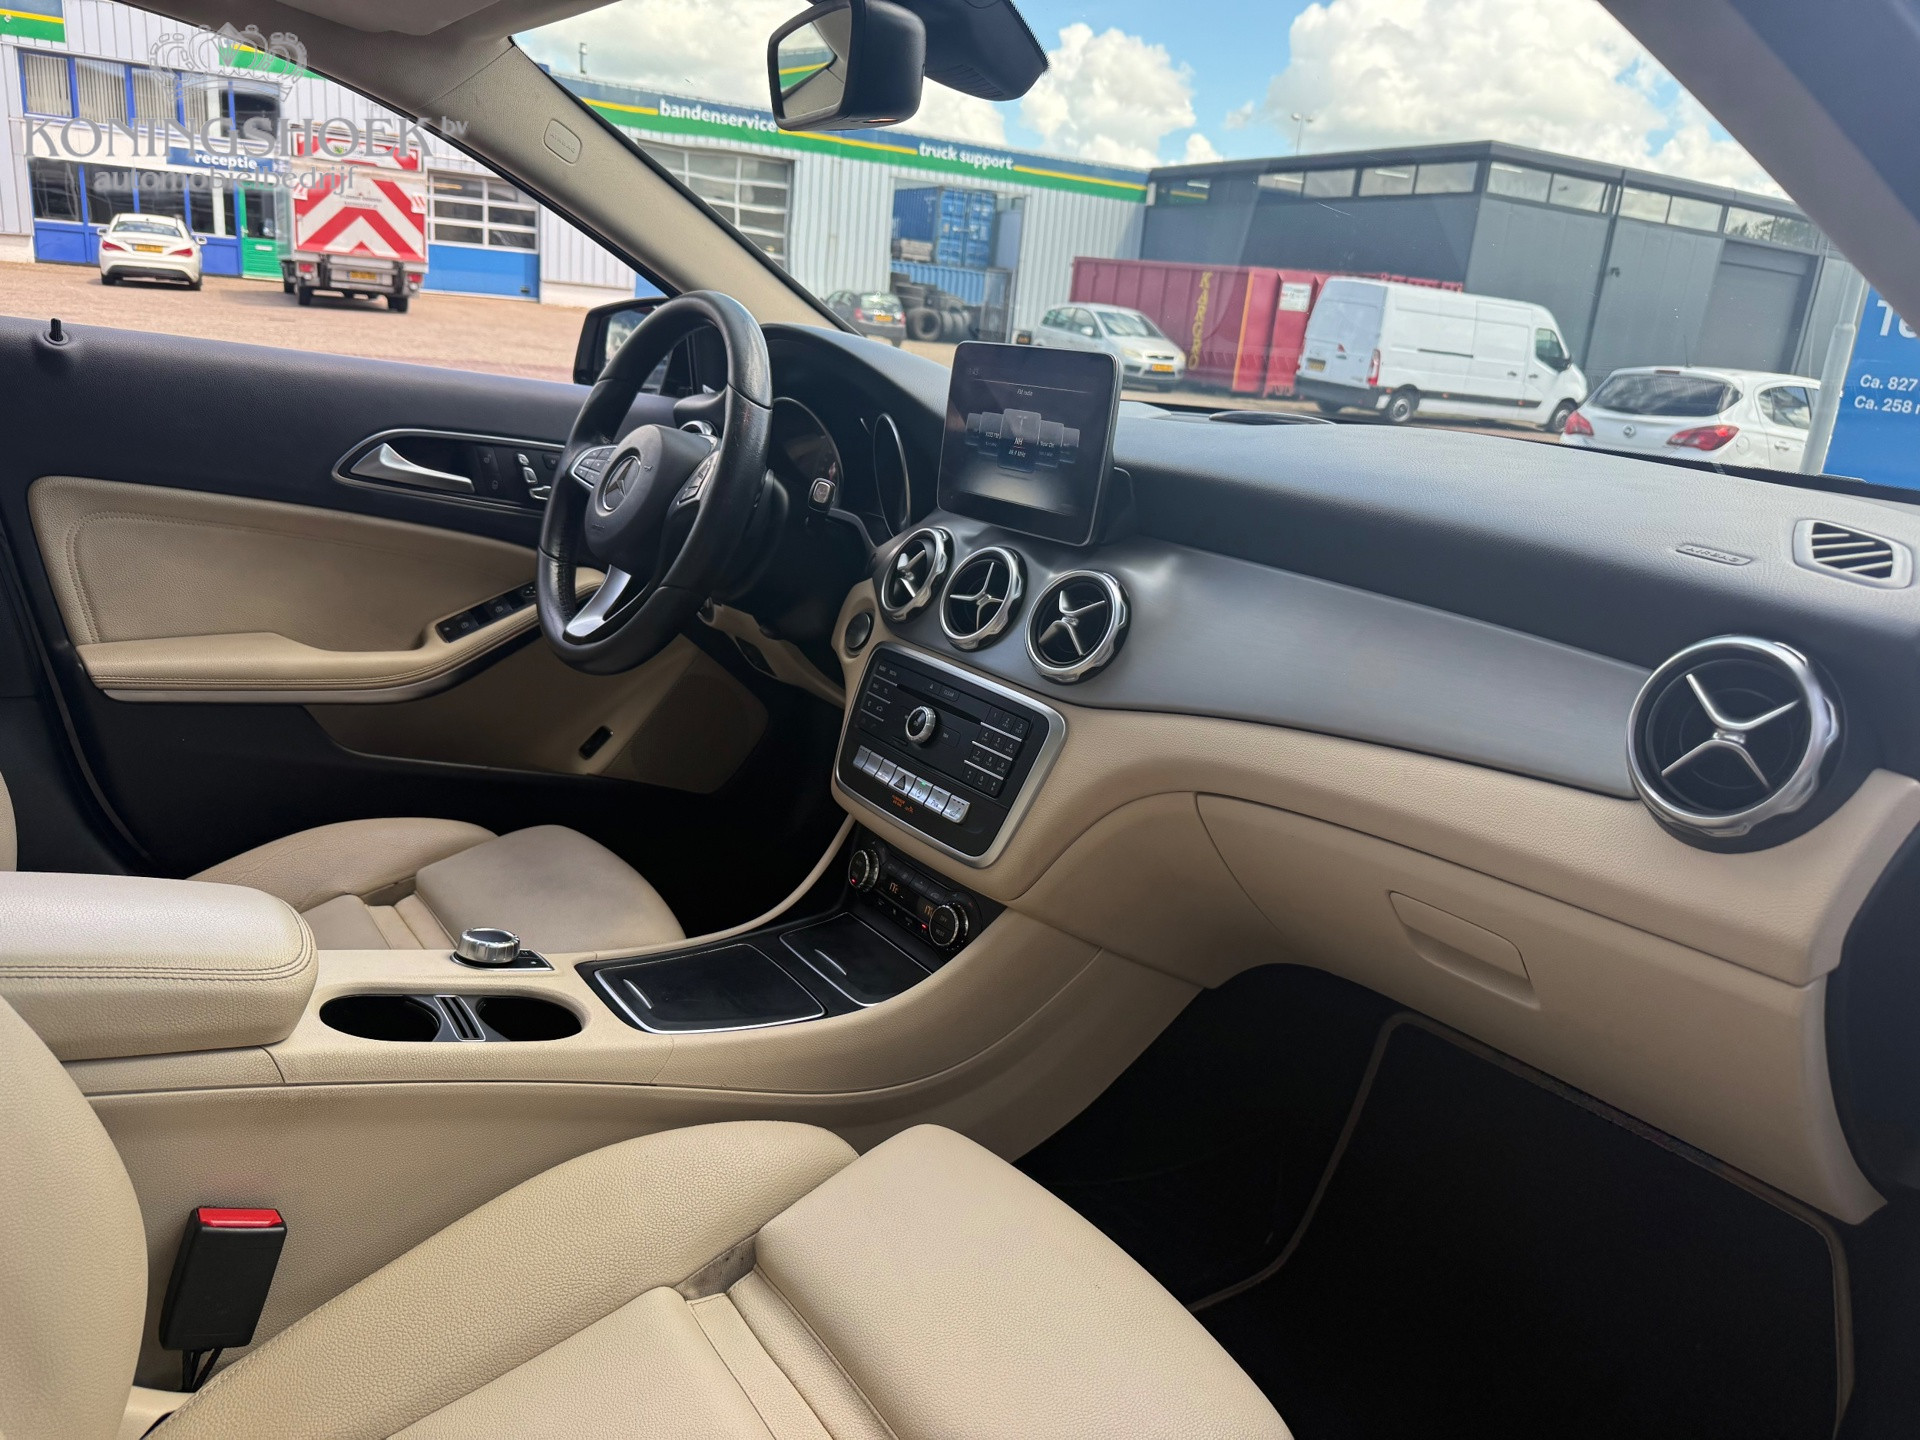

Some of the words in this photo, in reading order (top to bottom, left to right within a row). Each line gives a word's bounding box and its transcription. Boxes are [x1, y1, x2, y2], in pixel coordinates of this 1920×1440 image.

[659, 97, 778, 133] bandenservice
[194, 152, 258, 171] receptie
[919, 140, 957, 162] truck
[959, 151, 1014, 171] support
[1859, 373, 1884, 390] Ca.
[1887, 376, 1919, 392] 827
[1853, 395, 1879, 411] Ca.
[1881, 398, 1913, 414] 258
